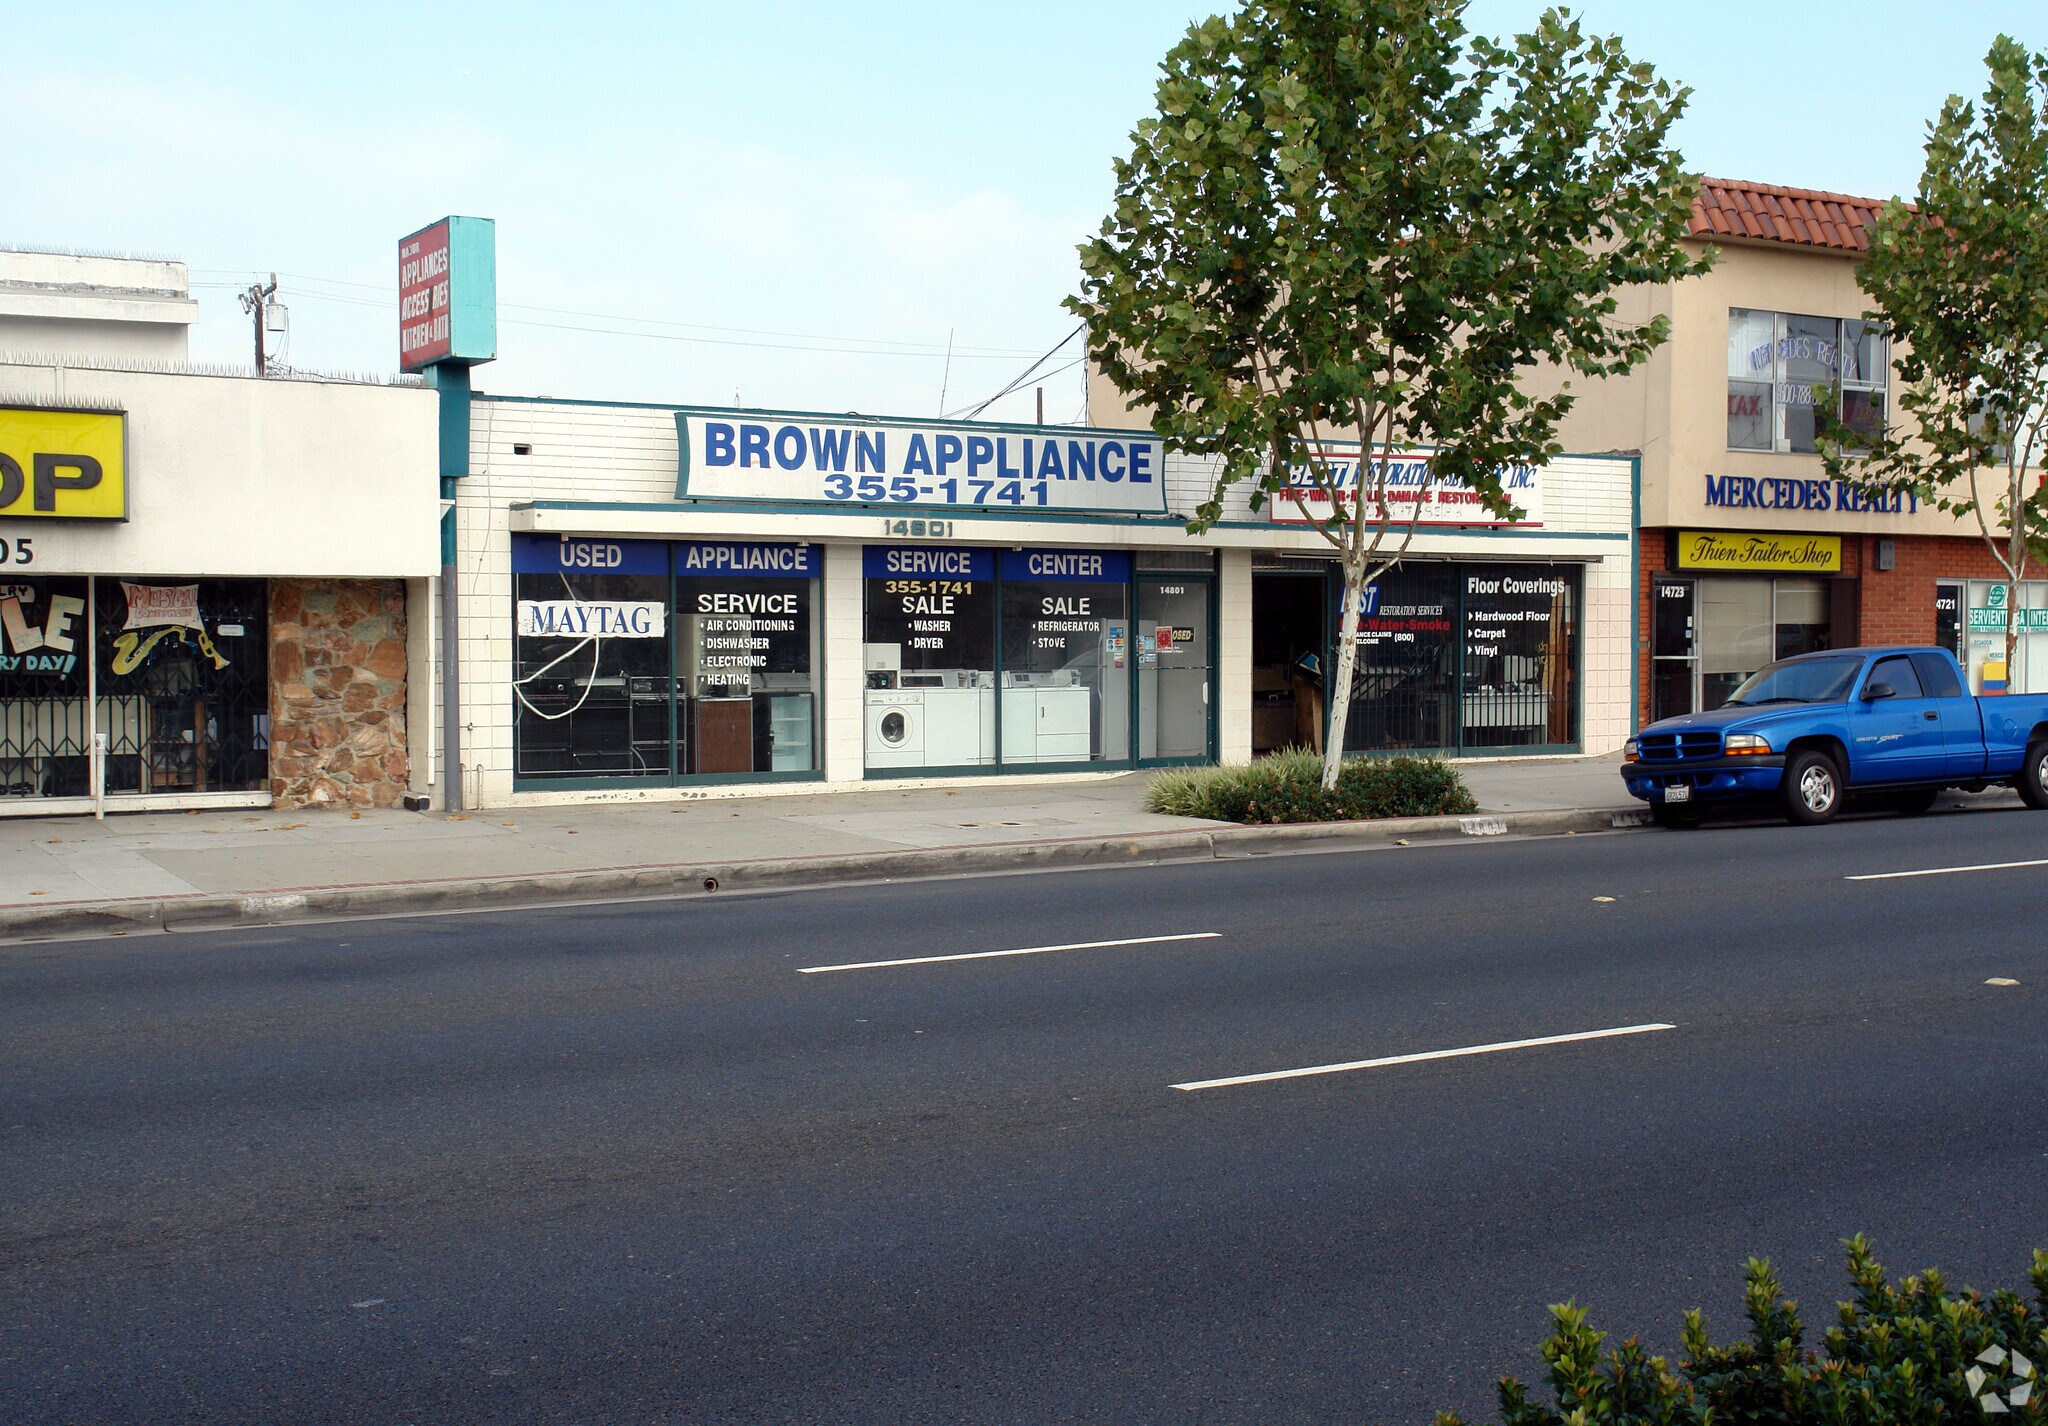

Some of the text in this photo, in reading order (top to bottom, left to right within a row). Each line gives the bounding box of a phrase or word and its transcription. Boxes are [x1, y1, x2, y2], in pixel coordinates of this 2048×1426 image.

[402, 247, 448, 289] APPLIANCES
[403, 322, 429, 353] KITCHEN
[1817, 341, 1857, 378] REATY
[705, 422, 1153, 484] BROWN APPLIANCE
[824, 474, 1048, 506] 355-1741
[1704, 474, 1831, 511] MERCEDES
[884, 519, 953, 538] 14801
[560, 543, 808, 571] USED APPLIANCE
[1690, 536, 1832, 568] Thien Tailor Shop
[887, 551, 1102, 576] SERVICE CENTER
[885, 581, 972, 595] 355-1741
[1160, 586, 1184, 594] 14801
[1468, 577, 1565, 597] Floor Coverings
[1661, 586, 1684, 598] 14723
[698, 593, 798, 614] SERVICE
[902, 596, 954, 615] SALE
[1042, 597, 1091, 615] SALE
[1936, 599, 1955, 610] 4721
[1379, 605, 1443, 616] RESTORATION SERVICES
[1475, 611, 1550, 621] Hardwood Floor
[1, 594, 85, 654] LE
[530, 605, 652, 634] MAYTAG
[706, 619, 795, 632] AIR CONDITIONING
[914, 620, 951, 632] WASHER
[1369, 619, 1407, 631] Water
[1409, 619, 1451, 631] Smoke
[1038, 621, 1100, 632] REFRIGERATOR
[1172, 630, 1191, 640] OSED
[1394, 633, 1414, 643] (800)
[1474, 628, 1506, 640] Carpet
[706, 637, 770, 649] DISHWASHER
[914, 637, 943, 649] DRYER
[1038, 637, 1066, 648] STOVE
[1475, 645, 1498, 657] Vinyl
[26, 654, 77, 681] DAY!
[707, 655, 767, 668] ELECTRONIC
[708, 673, 750, 685] HEATING
